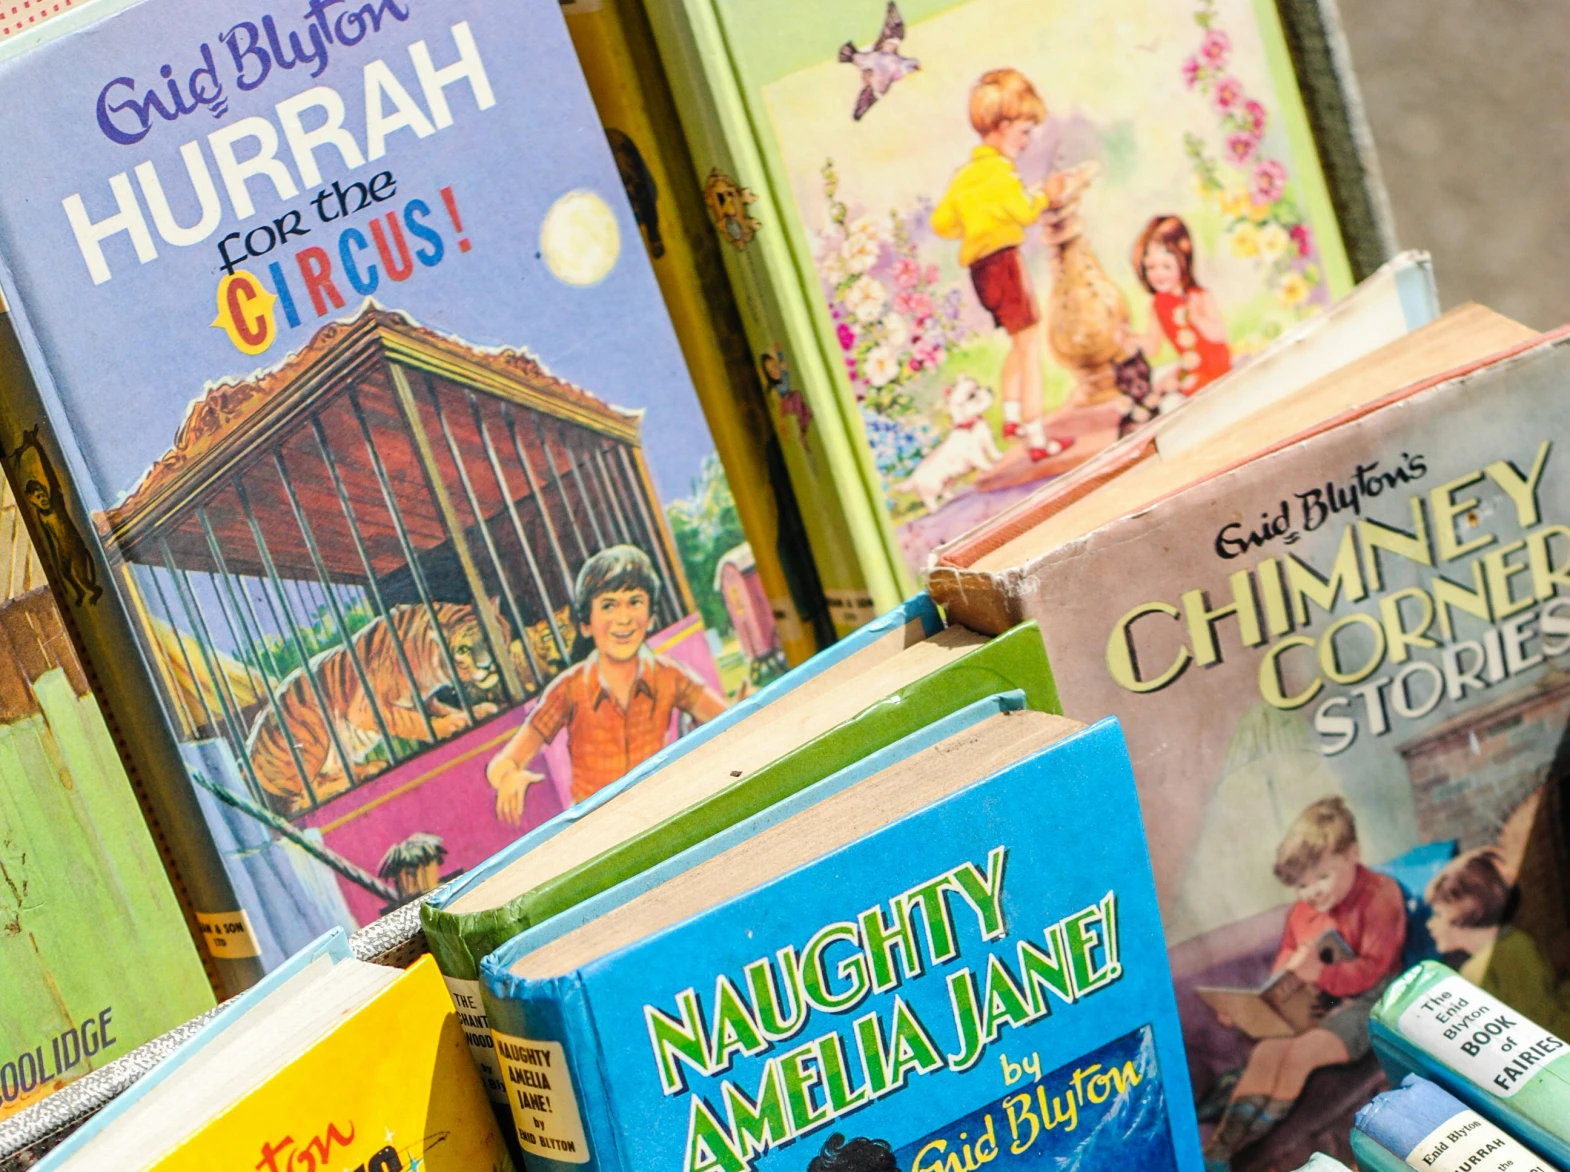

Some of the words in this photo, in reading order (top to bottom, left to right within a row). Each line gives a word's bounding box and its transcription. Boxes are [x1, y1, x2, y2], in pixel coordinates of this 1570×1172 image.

[96, 43, 229, 145] Enid
[219, 0, 410, 92] Blyton
[62, 20, 496, 285] HURRAH
[211, 210, 311, 275] for
[311, 171, 396, 225] the
[226, 186, 472, 346] CIRCUS!
[1214, 501, 1300, 559] Enid
[1294, 452, 1428, 531] Blyton's
[1106, 440, 1553, 693] CHIMNEY
[1259, 525, 1570, 710] CORNER
[1314, 600, 1570, 757] STORIES
[223, 922, 244, 934] SON
[643, 845, 1009, 1097] NAUGHTY
[945, 890, 1123, 1073] JANE!
[453, 992, 477, 1009] THE
[456, 1011, 490, 1029] CHANT
[1420, 991, 1452, 1013] The
[1435, 998, 1469, 1023] Enid
[1443, 1005, 1490, 1041] Blyton
[1460, 1015, 1517, 1057] BOOK
[1501, 1036, 1518, 1052] of
[0, 1006, 117, 1107] OOLIDGE
[497, 1039, 551, 1068] NAUGHTY
[1002, 1051, 1042, 1088] by
[1493, 1036, 1564, 1091] FAIRIES
[488, 1079, 507, 1093] Bly
[508, 1065, 552, 1091] AMELIA
[517, 1090, 553, 1114] JANE!
[1003, 1055, 1144, 1156] Blyton
[518, 1127, 537, 1145] ENID
[540, 1134, 576, 1153] BLYTON
[533, 1116, 545, 1132] by
[1422, 1142, 1450, 1167] Enid
[1446, 1119, 1482, 1144] Blyton
